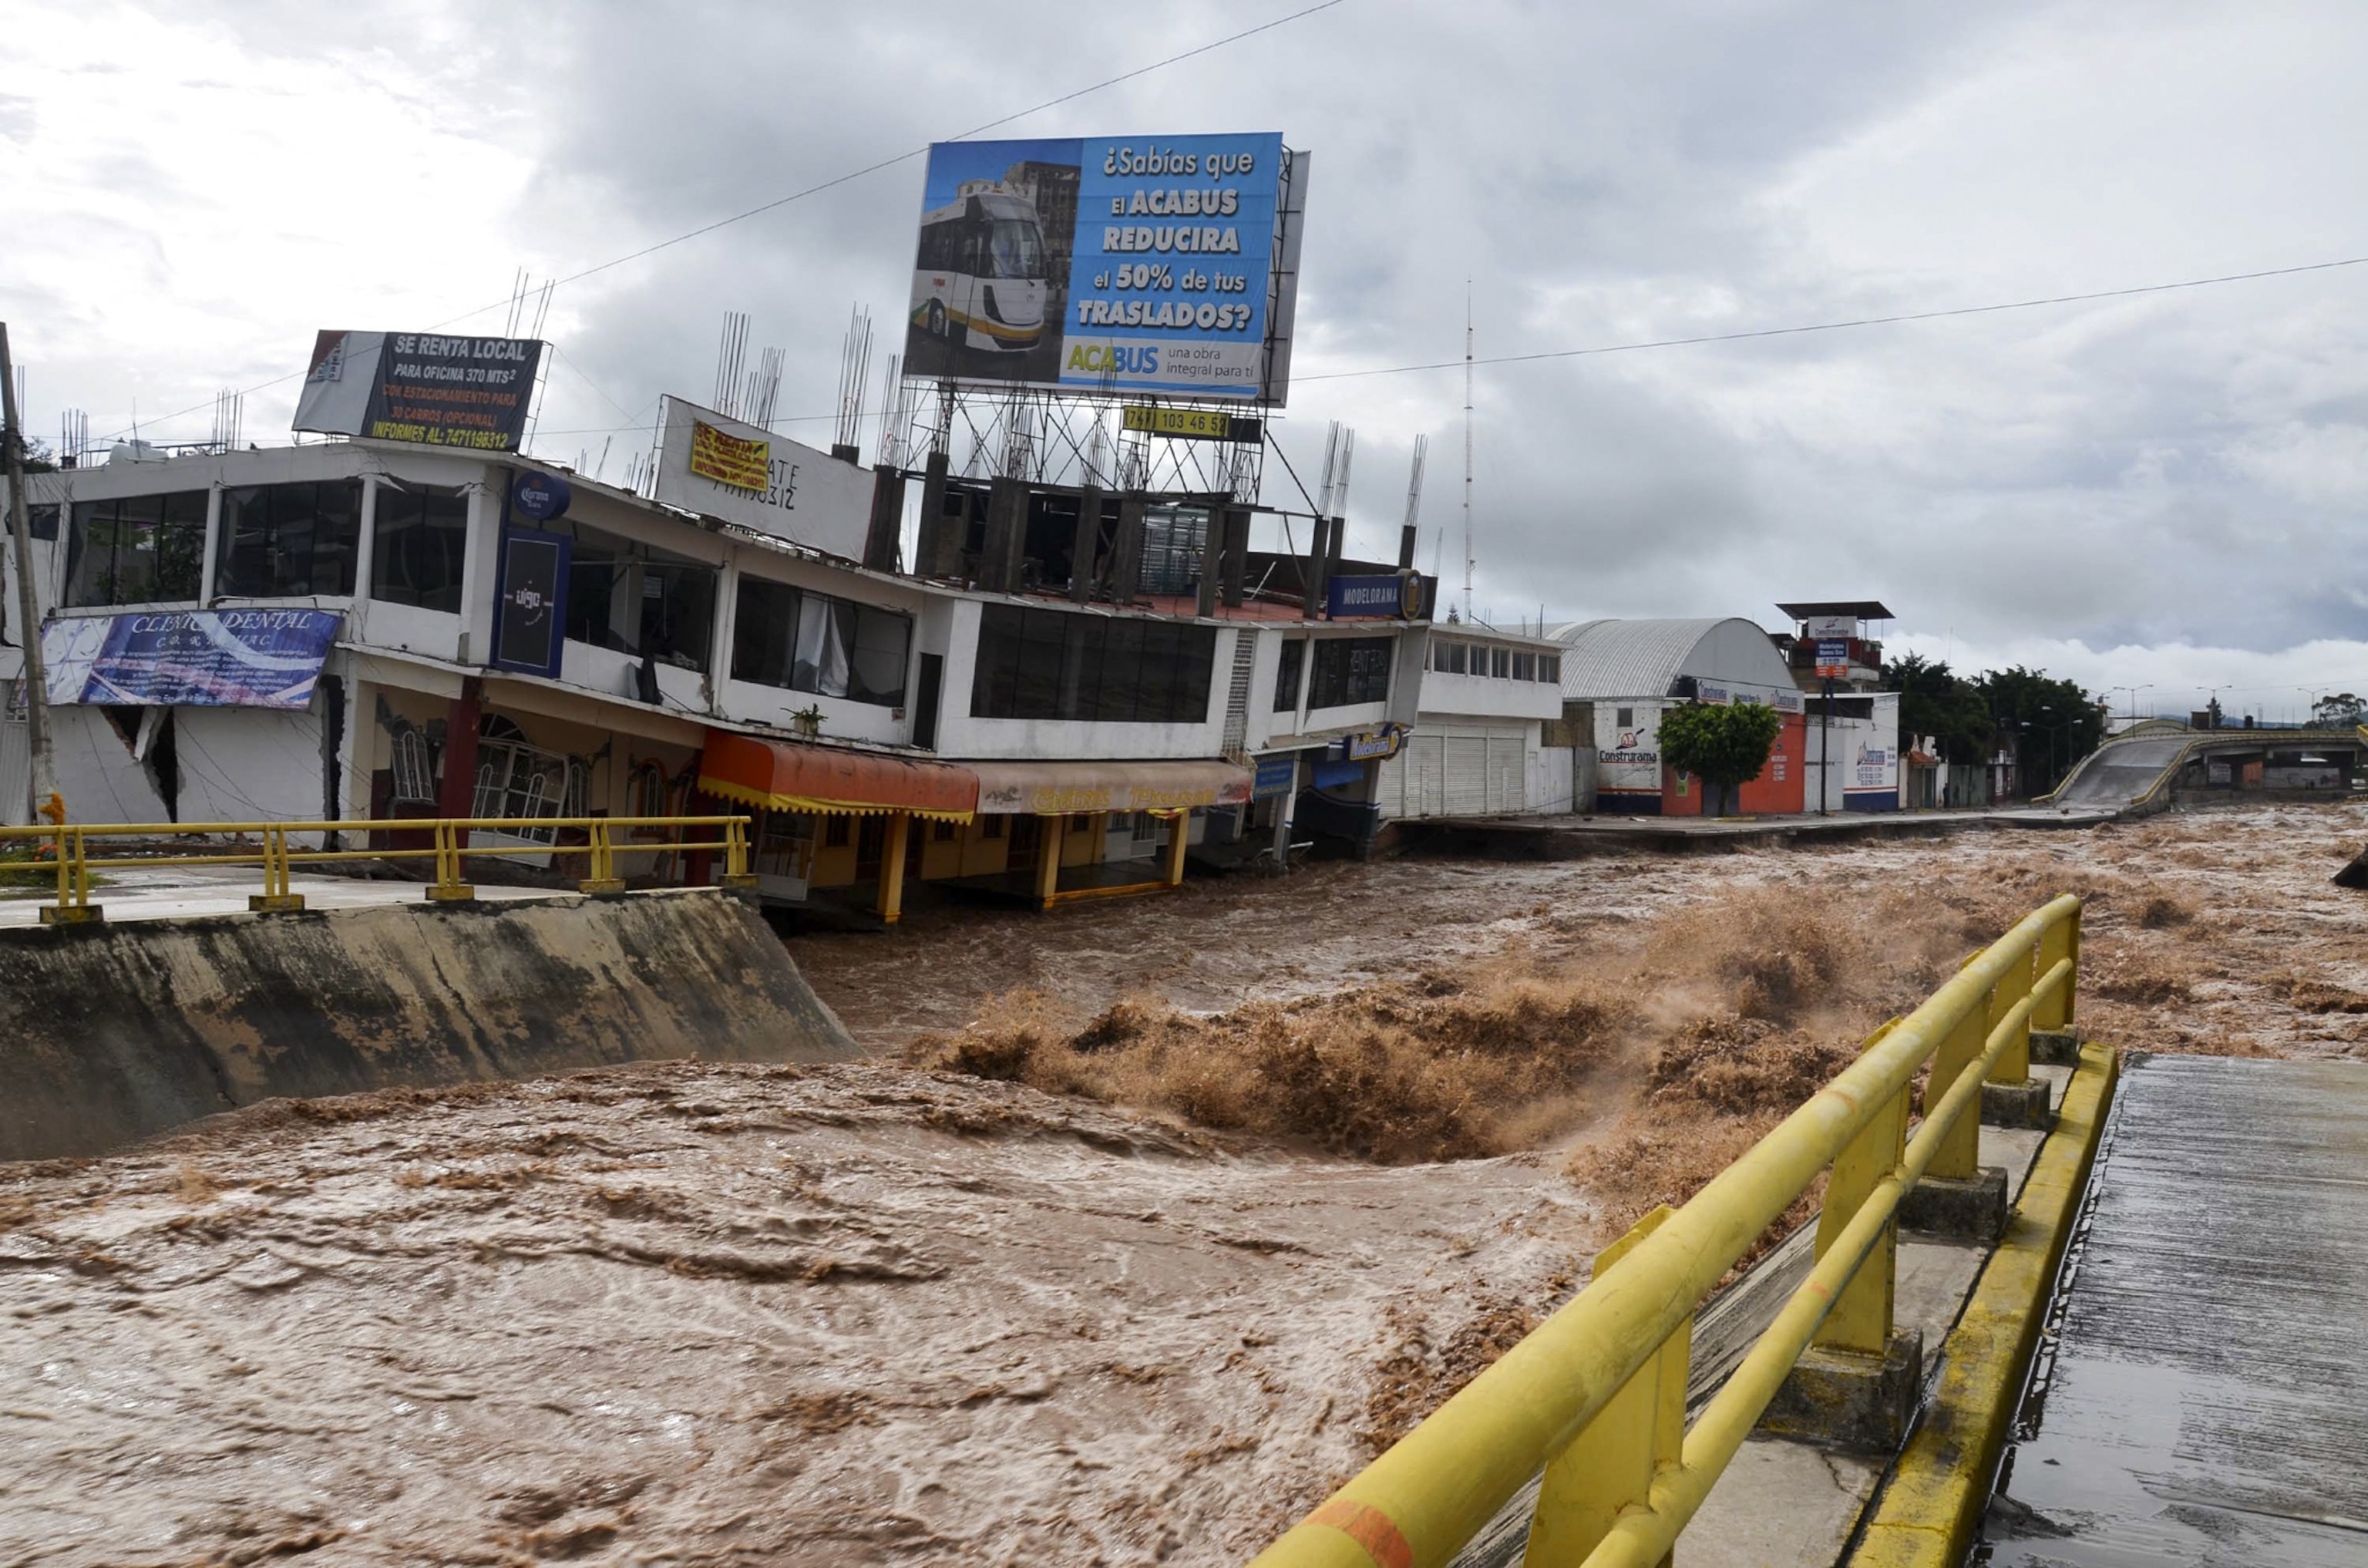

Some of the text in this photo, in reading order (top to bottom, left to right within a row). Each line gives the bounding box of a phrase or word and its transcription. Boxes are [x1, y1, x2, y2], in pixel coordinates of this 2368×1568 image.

[1104, 146, 1253, 180] ¿Sabías que
[1112, 189, 1238, 214] El ACABUS
[1103, 227, 1240, 251] REDUCIRA
[1094, 264, 1245, 291] el 50% de tus
[1078, 300, 1251, 329] TRASLADOS?
[395, 336, 526, 362] SE RENTA LOCAL
[1068, 345, 1159, 373] ACABUS
[1169, 348, 1220, 359] una obra
[394, 364, 421, 379] PARA
[423, 365, 464, 382] OFICINA
[466, 368, 486, 382] 370
[1166, 363, 1212, 377] integral
[1215, 366, 1241, 378] para
[403, 387, 490, 405] ESTACIONAMIENTO
[490, 392, 518, 407] PARA
[404, 408, 442, 423] CARROS
[1162, 413, 1184, 429] 103
[1189, 416, 1206, 430] 46
[372, 422, 426, 442] INFORMES
[521, 487, 549, 503] Corona
[1342, 587, 1398, 604] MODELORAMA
[132, 611, 313, 633] CLINIC DENTAL
[1351, 737, 1389, 757] Modelorama
[1599, 750, 1657, 762] Construrama
